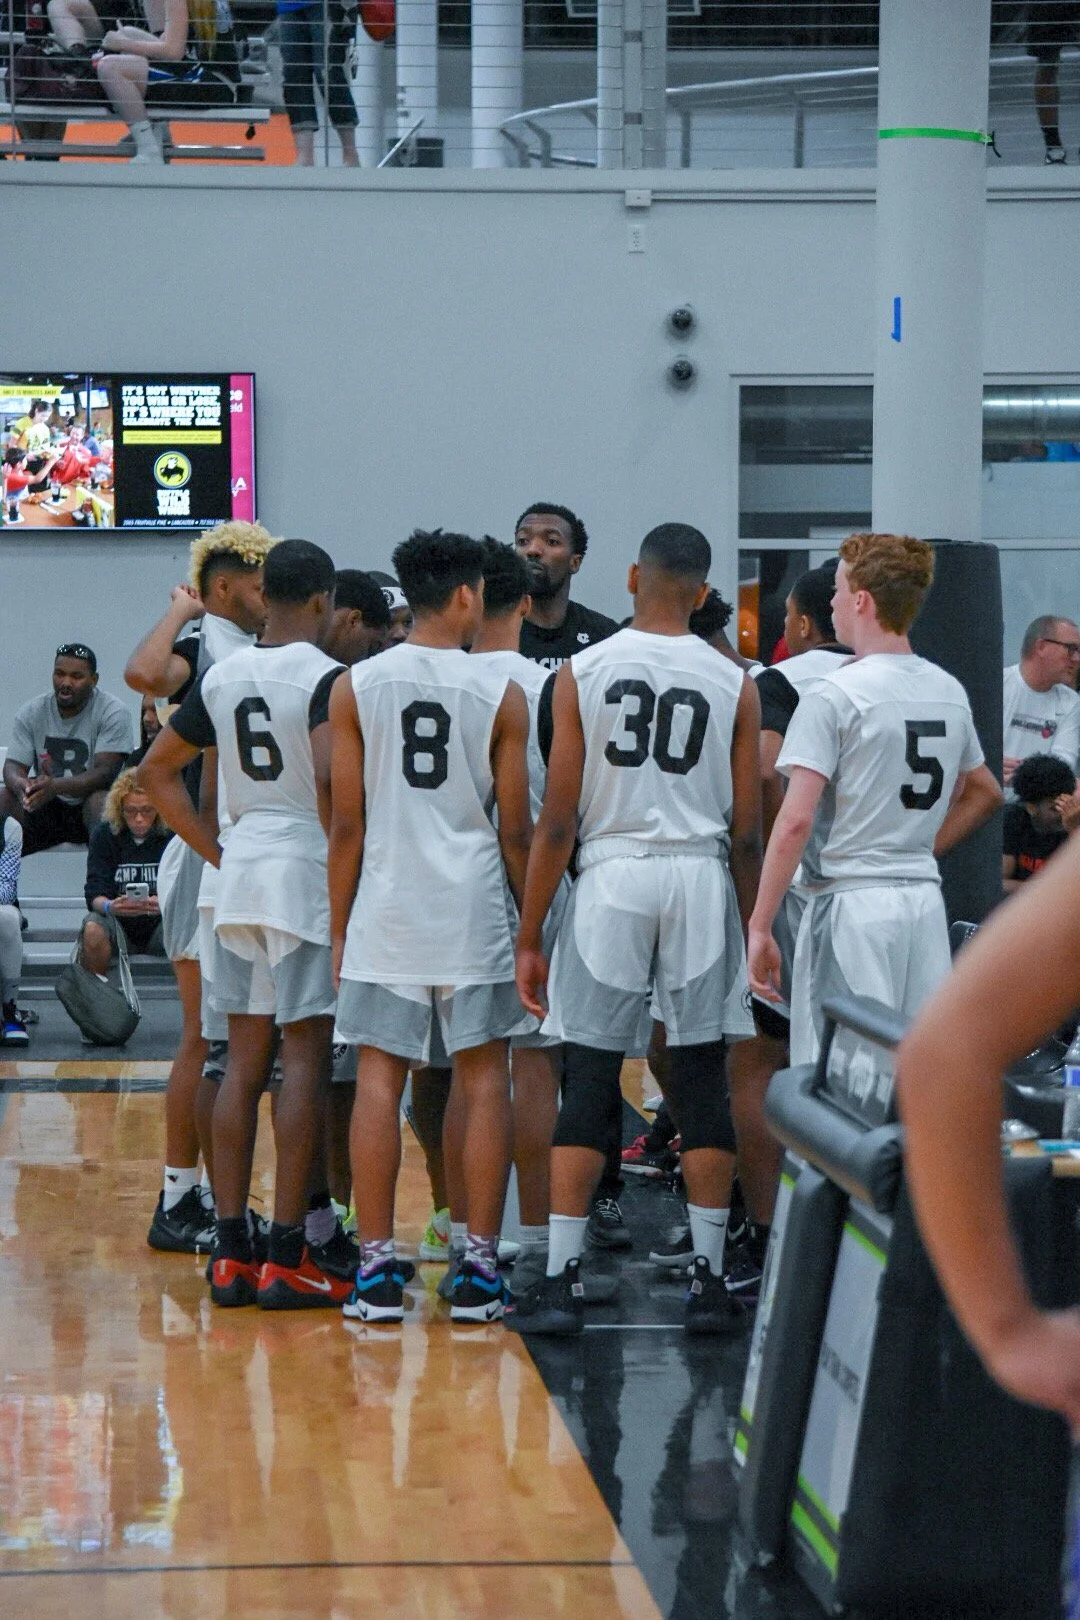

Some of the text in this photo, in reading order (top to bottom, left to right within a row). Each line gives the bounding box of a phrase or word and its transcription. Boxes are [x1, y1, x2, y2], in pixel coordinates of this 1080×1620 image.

[44, 736, 90, 778] R
[234, 696, 284, 781] 6
[401, 700, 451, 789] 8
[604, 678, 710, 775] 30
[899, 720, 946, 810] 5
